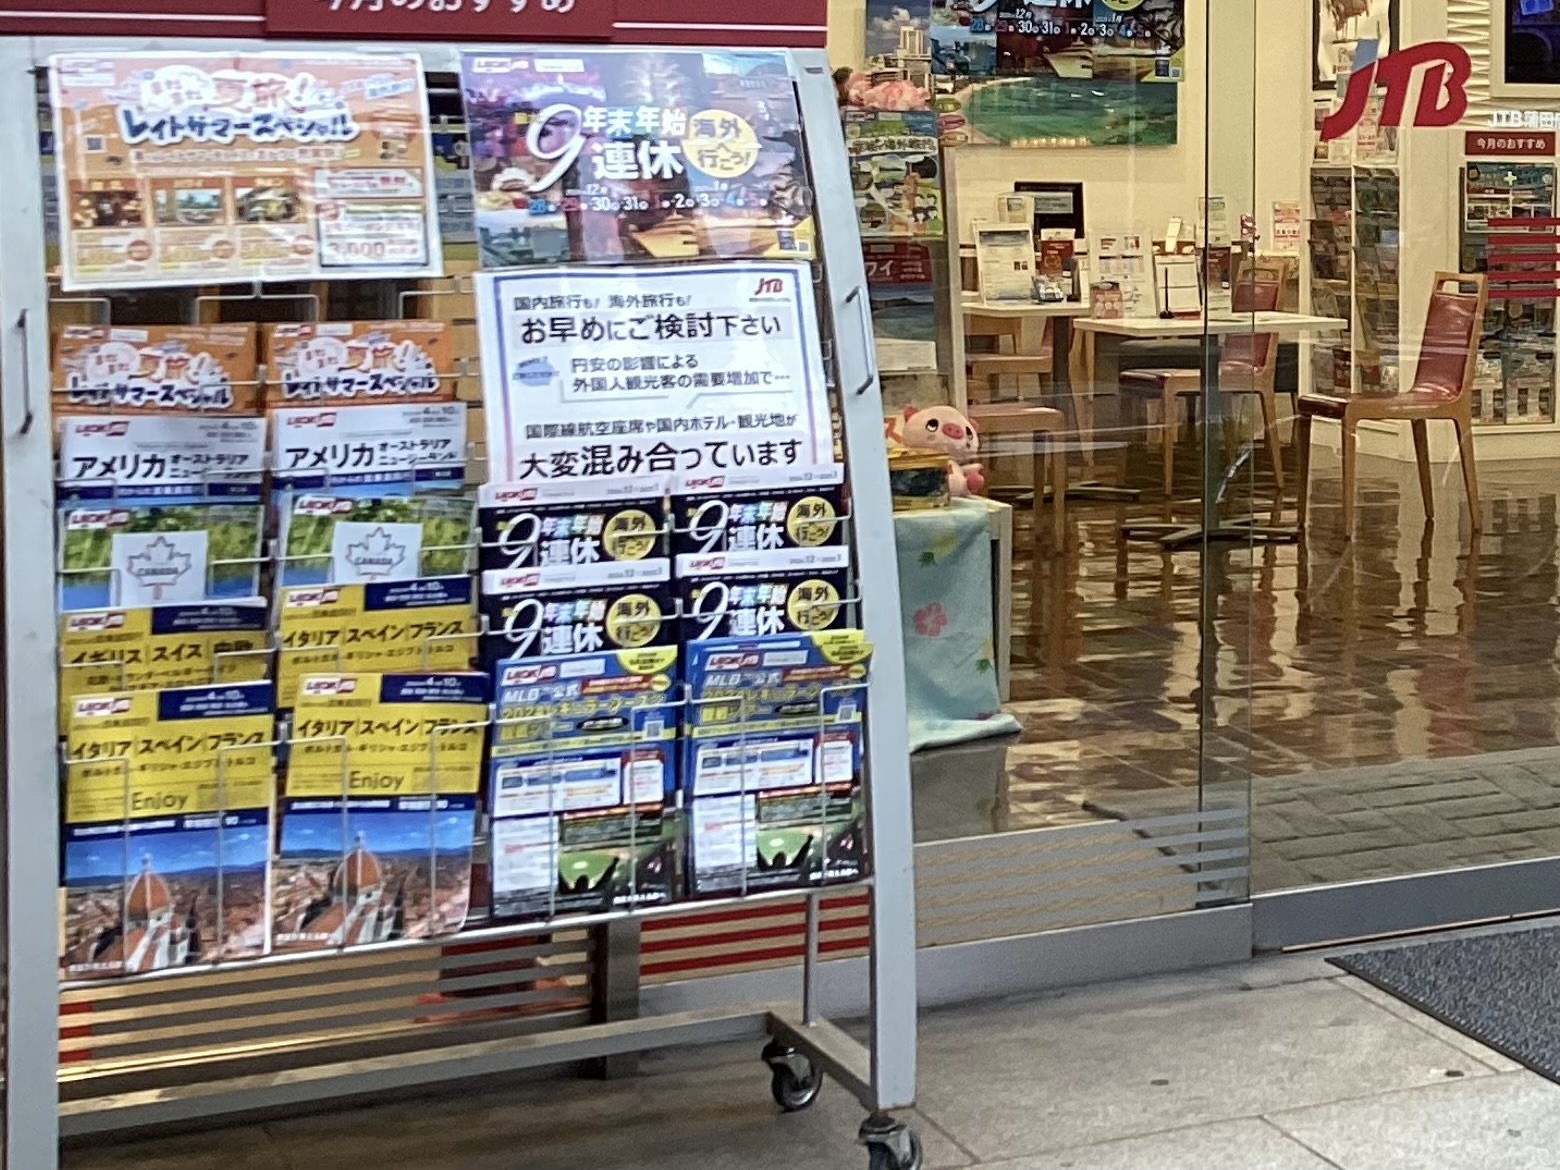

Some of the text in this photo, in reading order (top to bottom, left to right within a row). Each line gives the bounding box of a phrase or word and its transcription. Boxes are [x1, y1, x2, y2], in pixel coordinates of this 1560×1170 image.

[1319, 39, 1472, 141] JTB
[583, 105, 688, 139] 年末年始
[525, 102, 587, 193] 9
[1475, 137, 1546, 150] 今月のおすすめ
[591, 139, 684, 180] 連休
[754, 277, 784, 296] JTB
[521, 313, 782, 344] お早めにご検討下さい
[571, 354, 699, 373] 円安の影響による
[73, 453, 166, 479] アメリカ
[286, 439, 452, 468] アメリカ オーストラリア
[520, 438, 803, 480] 大変混み合っています
[727, 523, 785, 550] 連休
[541, 536, 601, 567] 連休
[346, 625, 405, 643] スペイン
[727, 606, 786, 637] 連休
[541, 623, 604, 655] 連休
[152, 643, 203, 663] スイス
[297, 719, 355, 738] イタリア
[361, 717, 419, 736] スペイン
[71, 739, 132, 761] イタリア
[138, 735, 202, 756] スペイン
[348, 769, 405, 792] Enjoy
[131, 792, 188, 814] Enjoy
